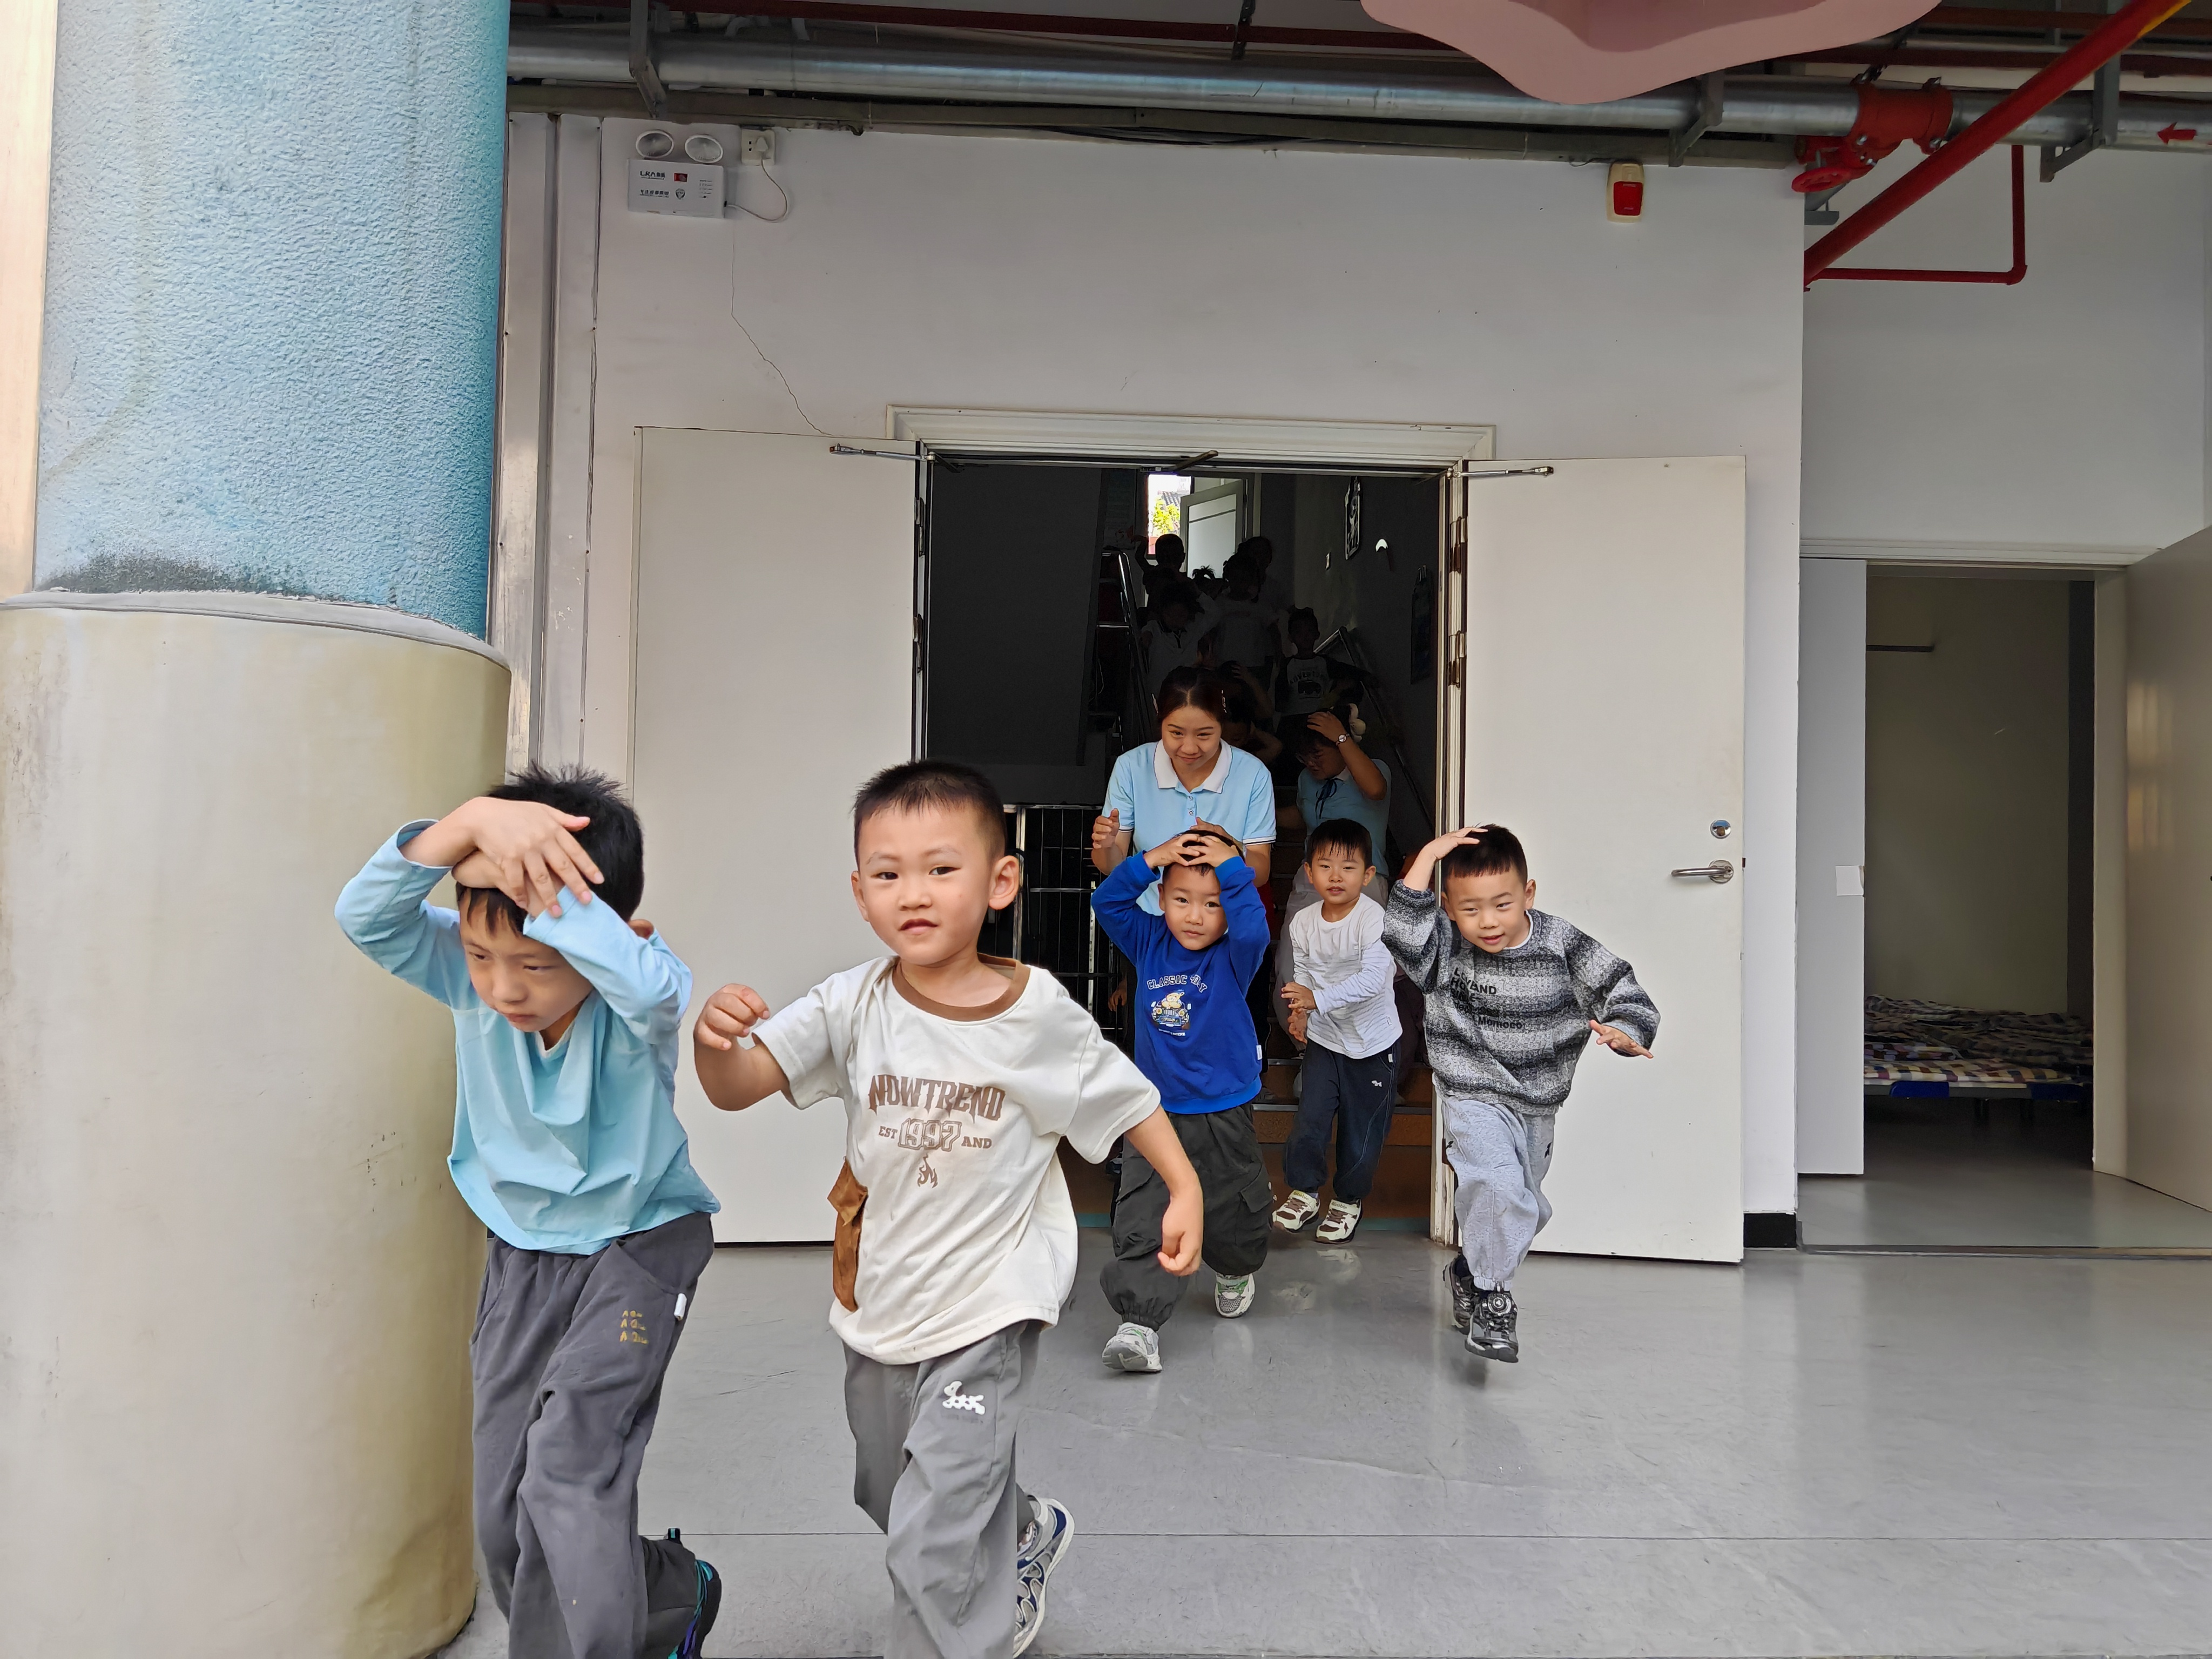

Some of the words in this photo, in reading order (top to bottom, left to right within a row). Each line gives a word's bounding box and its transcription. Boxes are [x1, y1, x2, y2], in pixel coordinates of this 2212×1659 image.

[1147, 974, 1188, 990] CLASSIC
[868, 1074, 1006, 1124] NOWTREND
[878, 1125, 899, 1139] EST
[898, 1117, 963, 1152] 1997
[961, 1136, 993, 1149] AND
